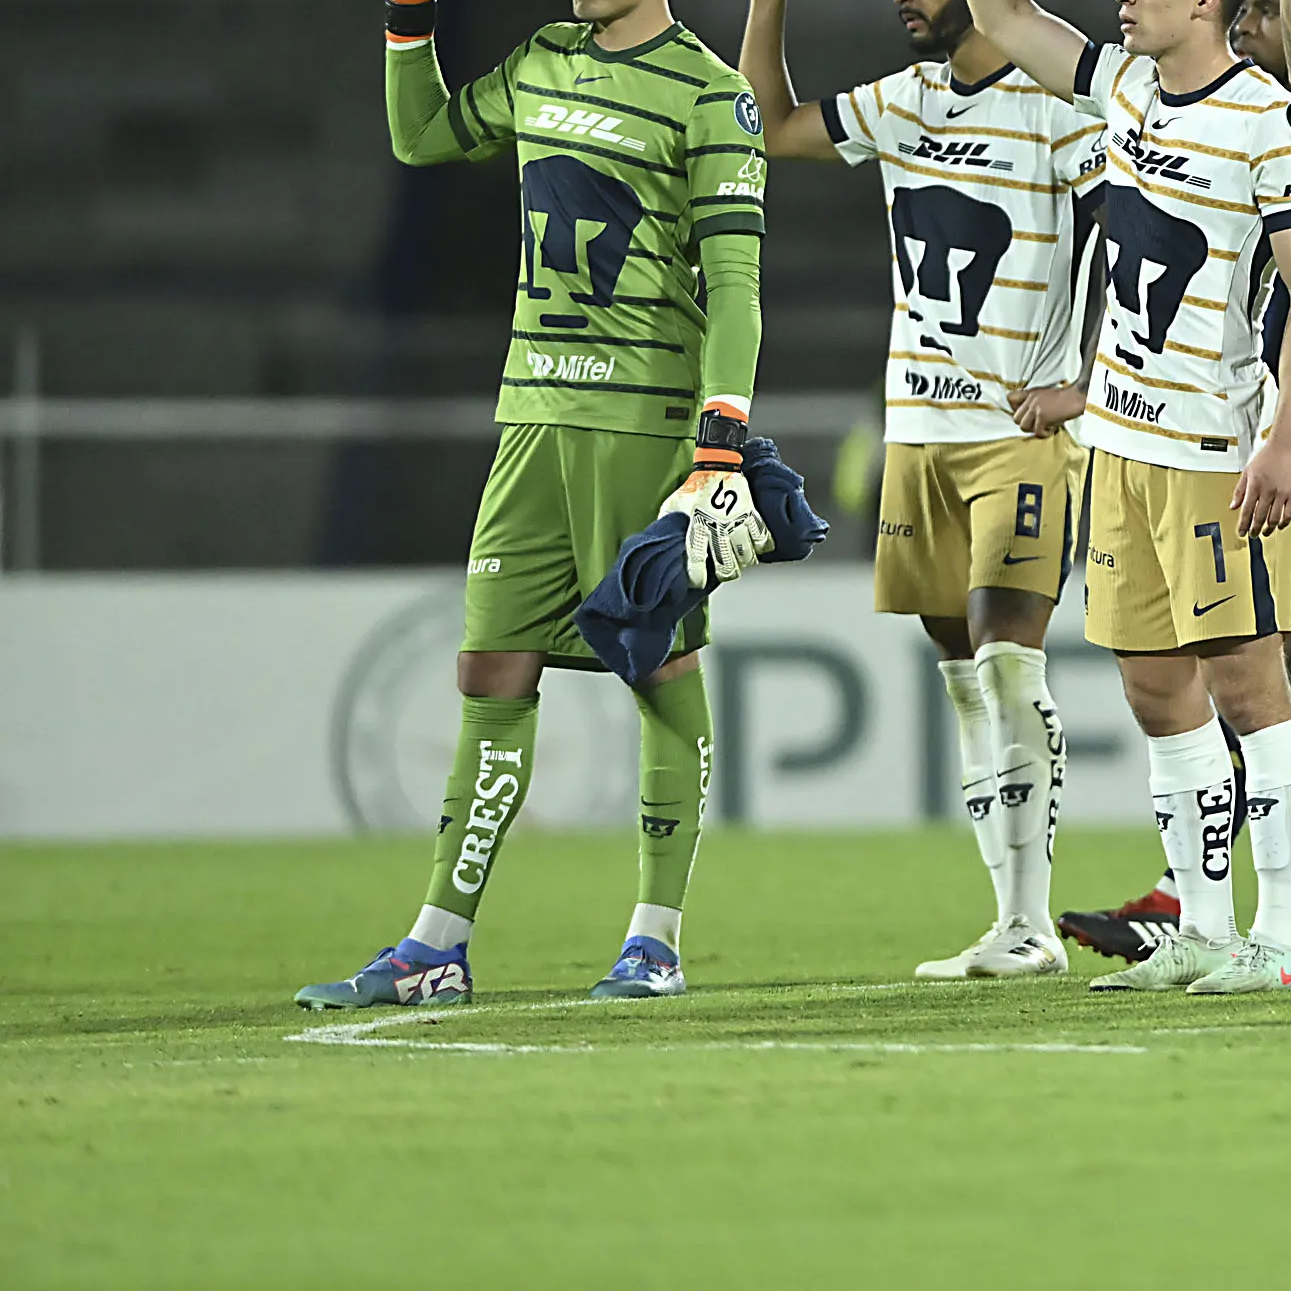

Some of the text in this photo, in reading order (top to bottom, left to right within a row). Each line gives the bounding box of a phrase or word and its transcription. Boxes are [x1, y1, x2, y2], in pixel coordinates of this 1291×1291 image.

[535, 104, 624, 145] DHL
[911, 135, 992, 168] DHL
[1122, 128, 1190, 182] DHL
[554, 356, 615, 381] Mifel
[933, 376, 982, 400] Mifel
[1016, 482, 1043, 538] 8
[1194, 521, 1227, 584] 7
[451, 740, 524, 894] CREST
